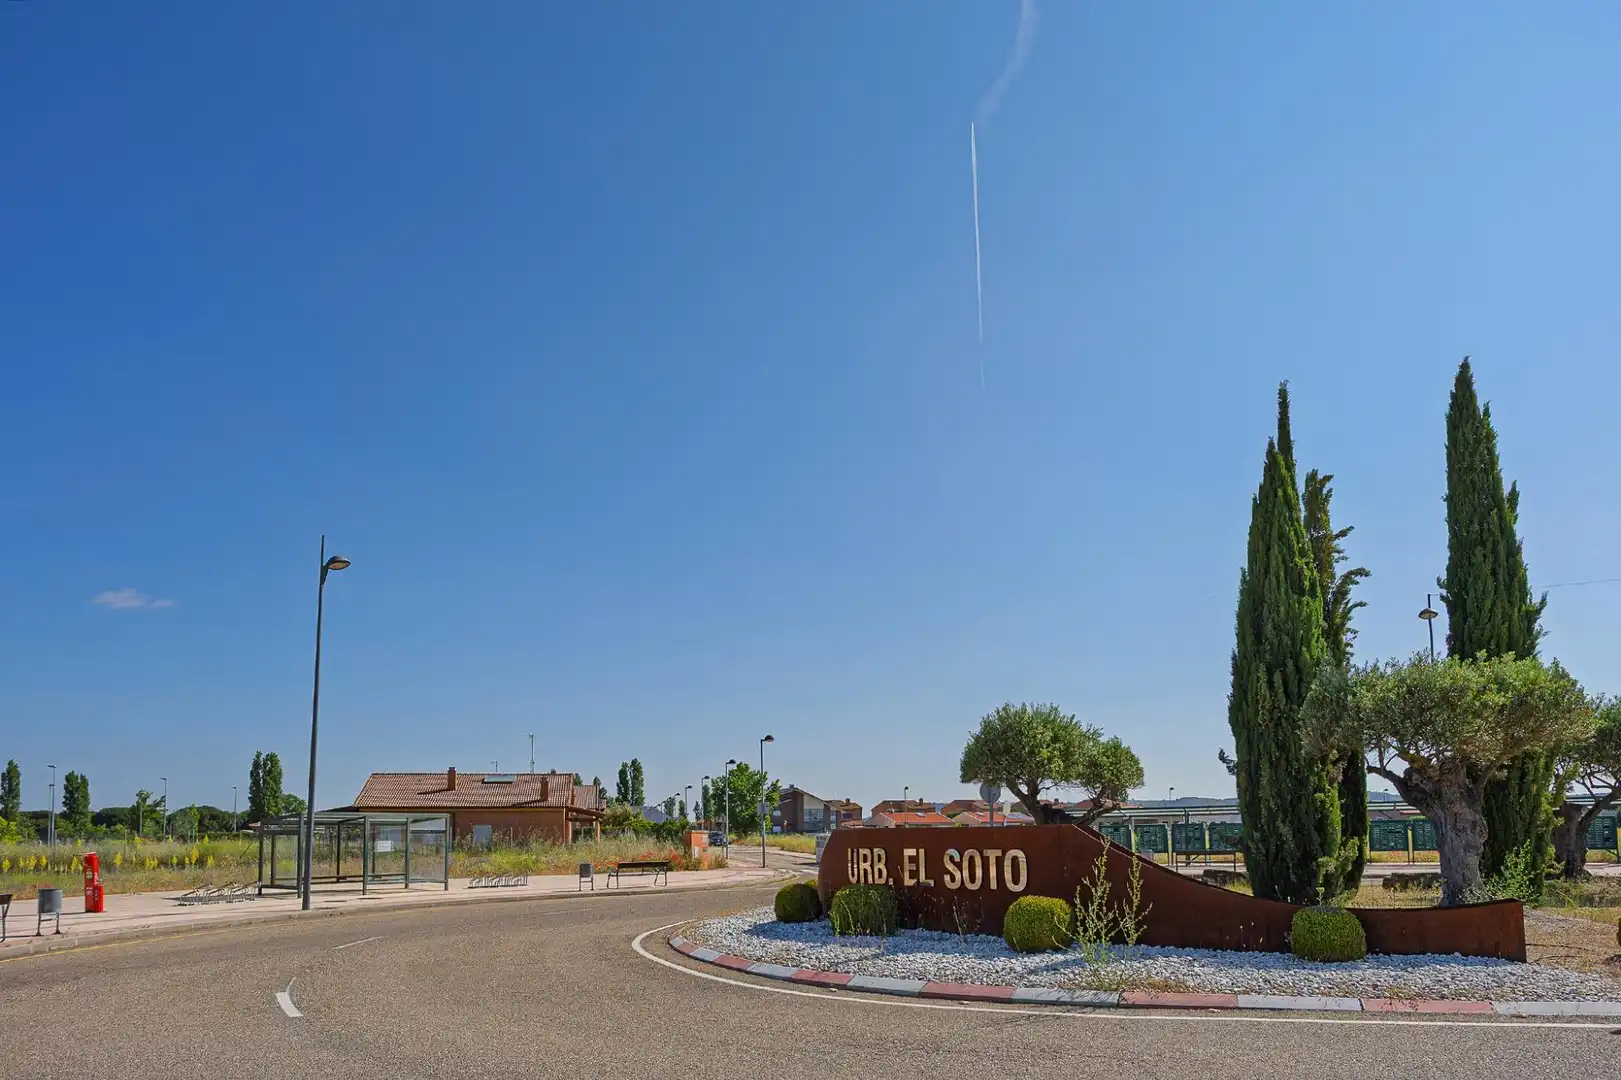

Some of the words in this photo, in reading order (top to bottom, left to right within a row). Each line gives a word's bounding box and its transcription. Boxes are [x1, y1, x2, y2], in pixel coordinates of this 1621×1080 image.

[847, 848, 894, 885] URB.
[903, 848, 935, 887] EL
[943, 848, 1028, 892] SOTO
